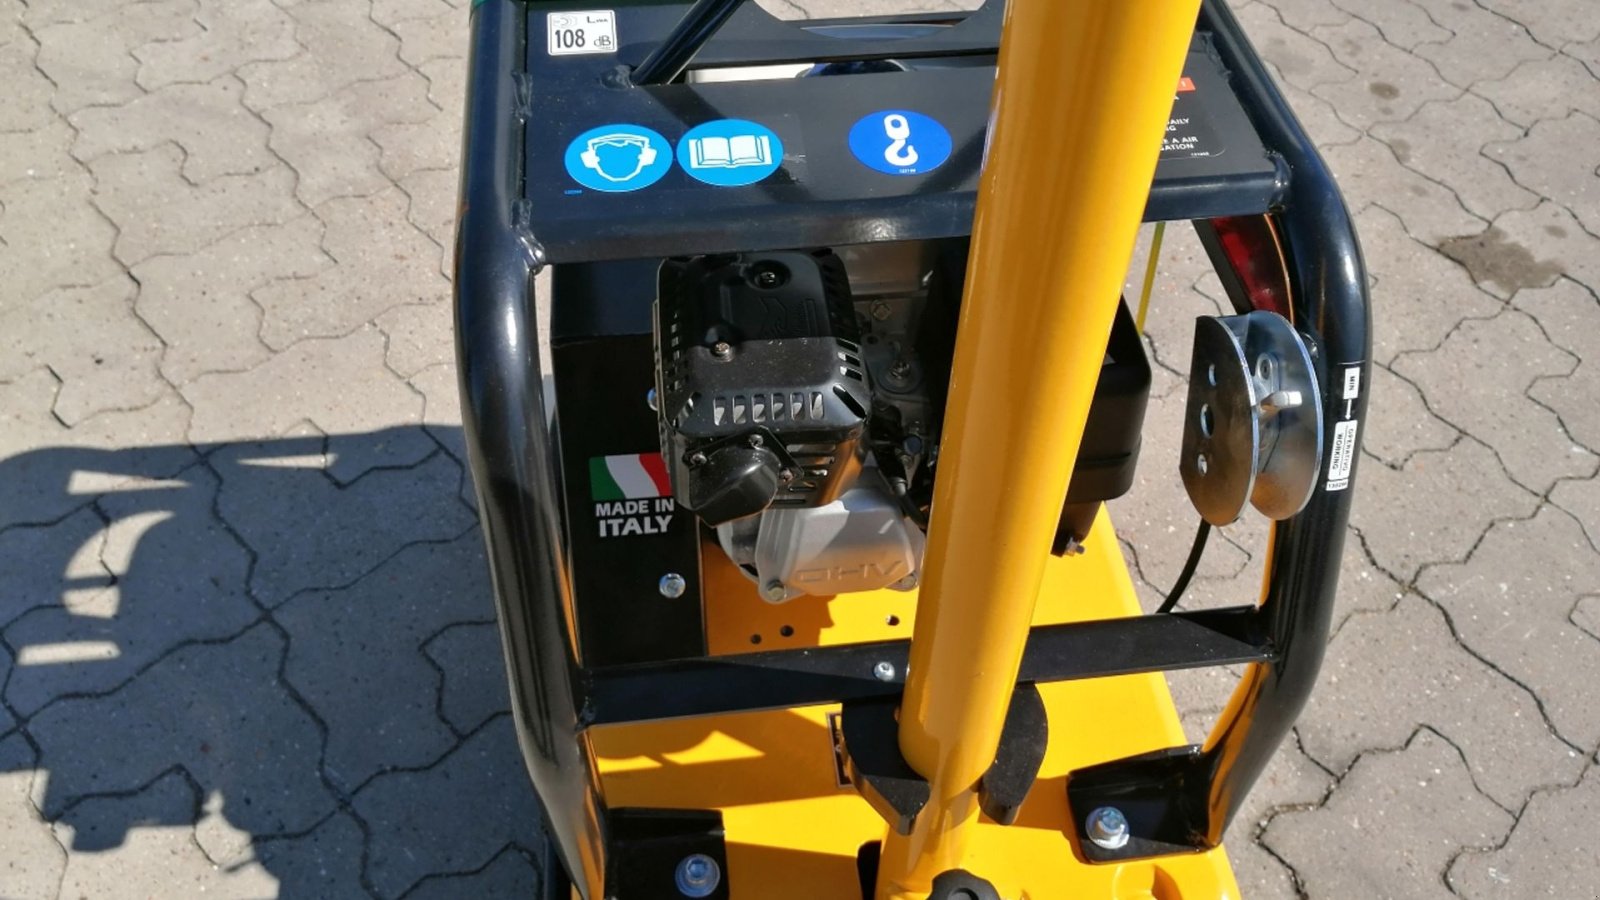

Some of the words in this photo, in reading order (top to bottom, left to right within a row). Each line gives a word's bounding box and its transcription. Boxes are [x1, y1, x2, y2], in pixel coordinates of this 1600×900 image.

[555, 28, 586, 49] 108
[593, 35, 612, 47] dB
[1348, 375, 1356, 391] MIN
[1332, 433, 1343, 471] WORKING
[595, 500, 649, 517] MADE
[655, 498, 675, 512] IN
[599, 515, 673, 538] ITALY
